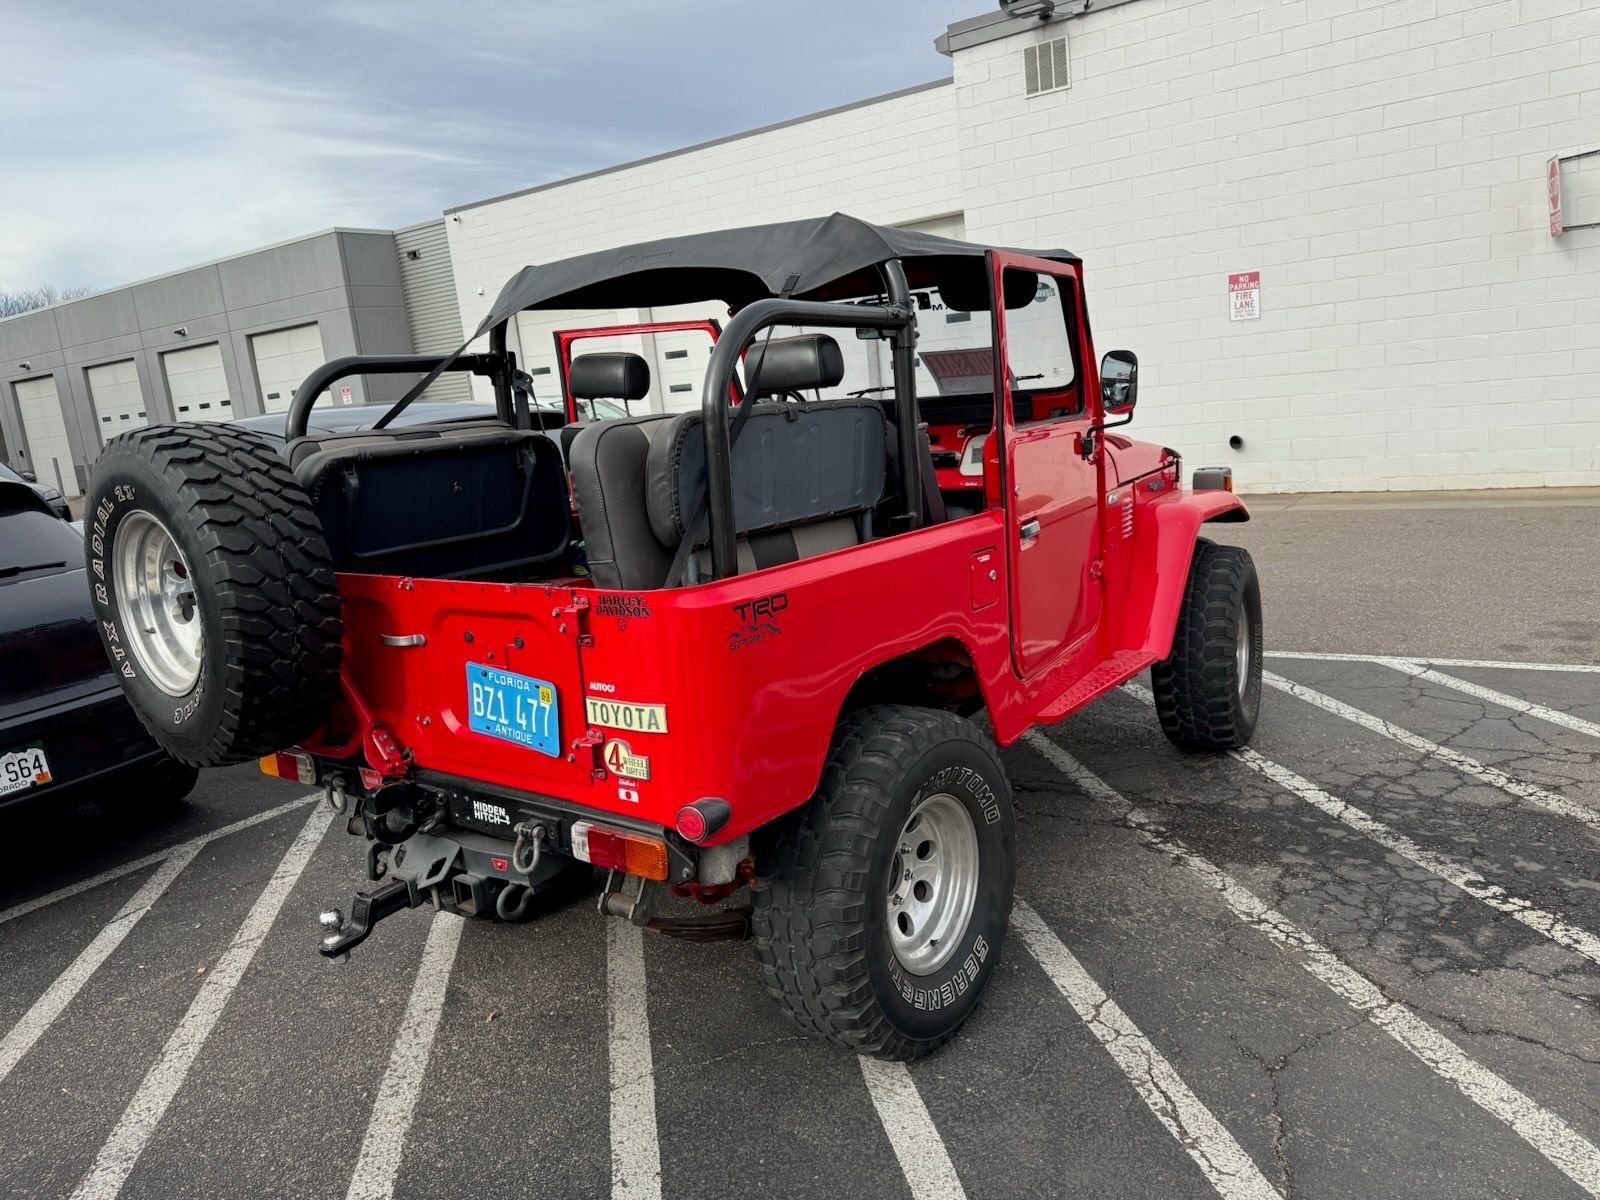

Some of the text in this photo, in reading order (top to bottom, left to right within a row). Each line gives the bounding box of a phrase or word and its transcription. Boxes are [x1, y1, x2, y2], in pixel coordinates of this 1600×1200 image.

[1229, 281, 1259, 290] PARKING
[1236, 291, 1253, 300] FIRE
[1234, 300, 1256, 310] LANE
[92, 497, 115, 605] RADIAL
[598, 595, 644, 606] HARLEY
[733, 592, 788, 623] TRD
[597, 605, 650, 617] DAVIDSON
[102, 620, 137, 678] ATX
[488, 672, 530, 692] FLORIDA
[472, 682, 550, 737] BZ1 477
[590, 701, 660, 730] TOYOTA
[495, 724, 533, 745] ANTIQUE
[609, 742, 624, 773] 4
[622, 756, 649, 770] WHEEL
[626, 766, 649, 778] DRIVE
[473, 800, 506, 817] HIDDEN
[474, 810, 500, 825] HITCH
[887, 934, 989, 1011] SERENGETI
